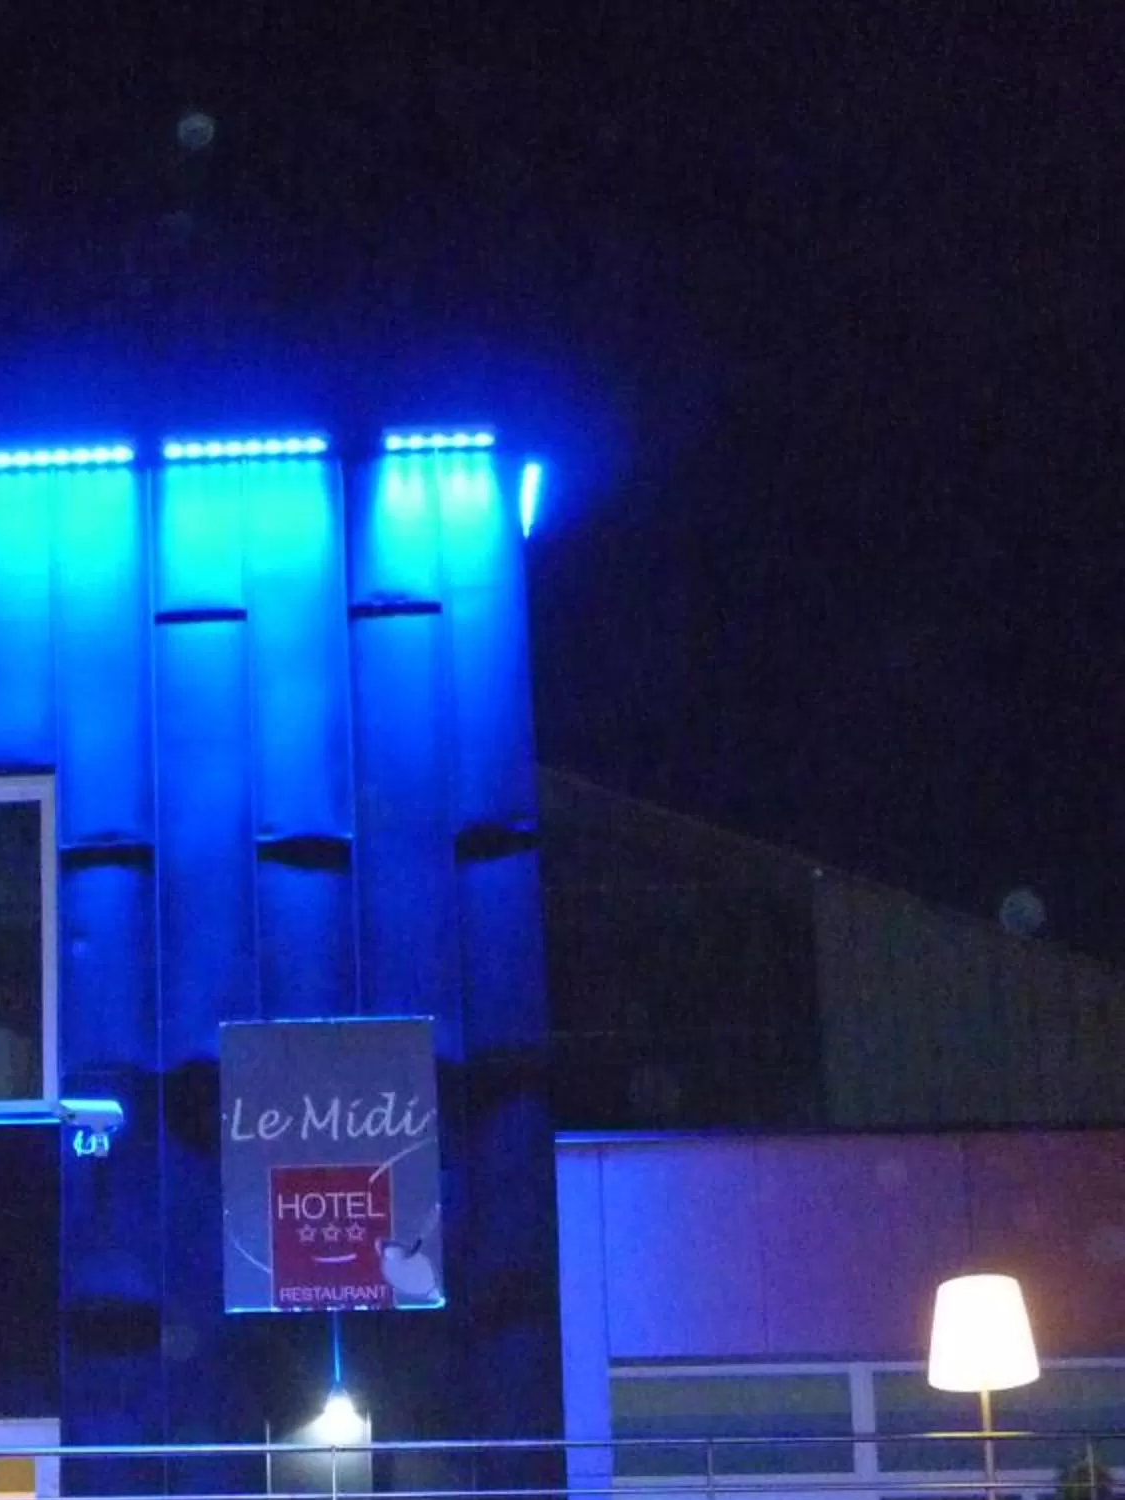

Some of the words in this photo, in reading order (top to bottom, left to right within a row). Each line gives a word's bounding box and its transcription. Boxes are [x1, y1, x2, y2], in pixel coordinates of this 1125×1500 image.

[230, 1096, 294, 1142] Le
[300, 1091, 436, 1142] Midi
[277, 1191, 386, 1221] HOTEL
[278, 1283, 389, 1303] RESTAURANT
